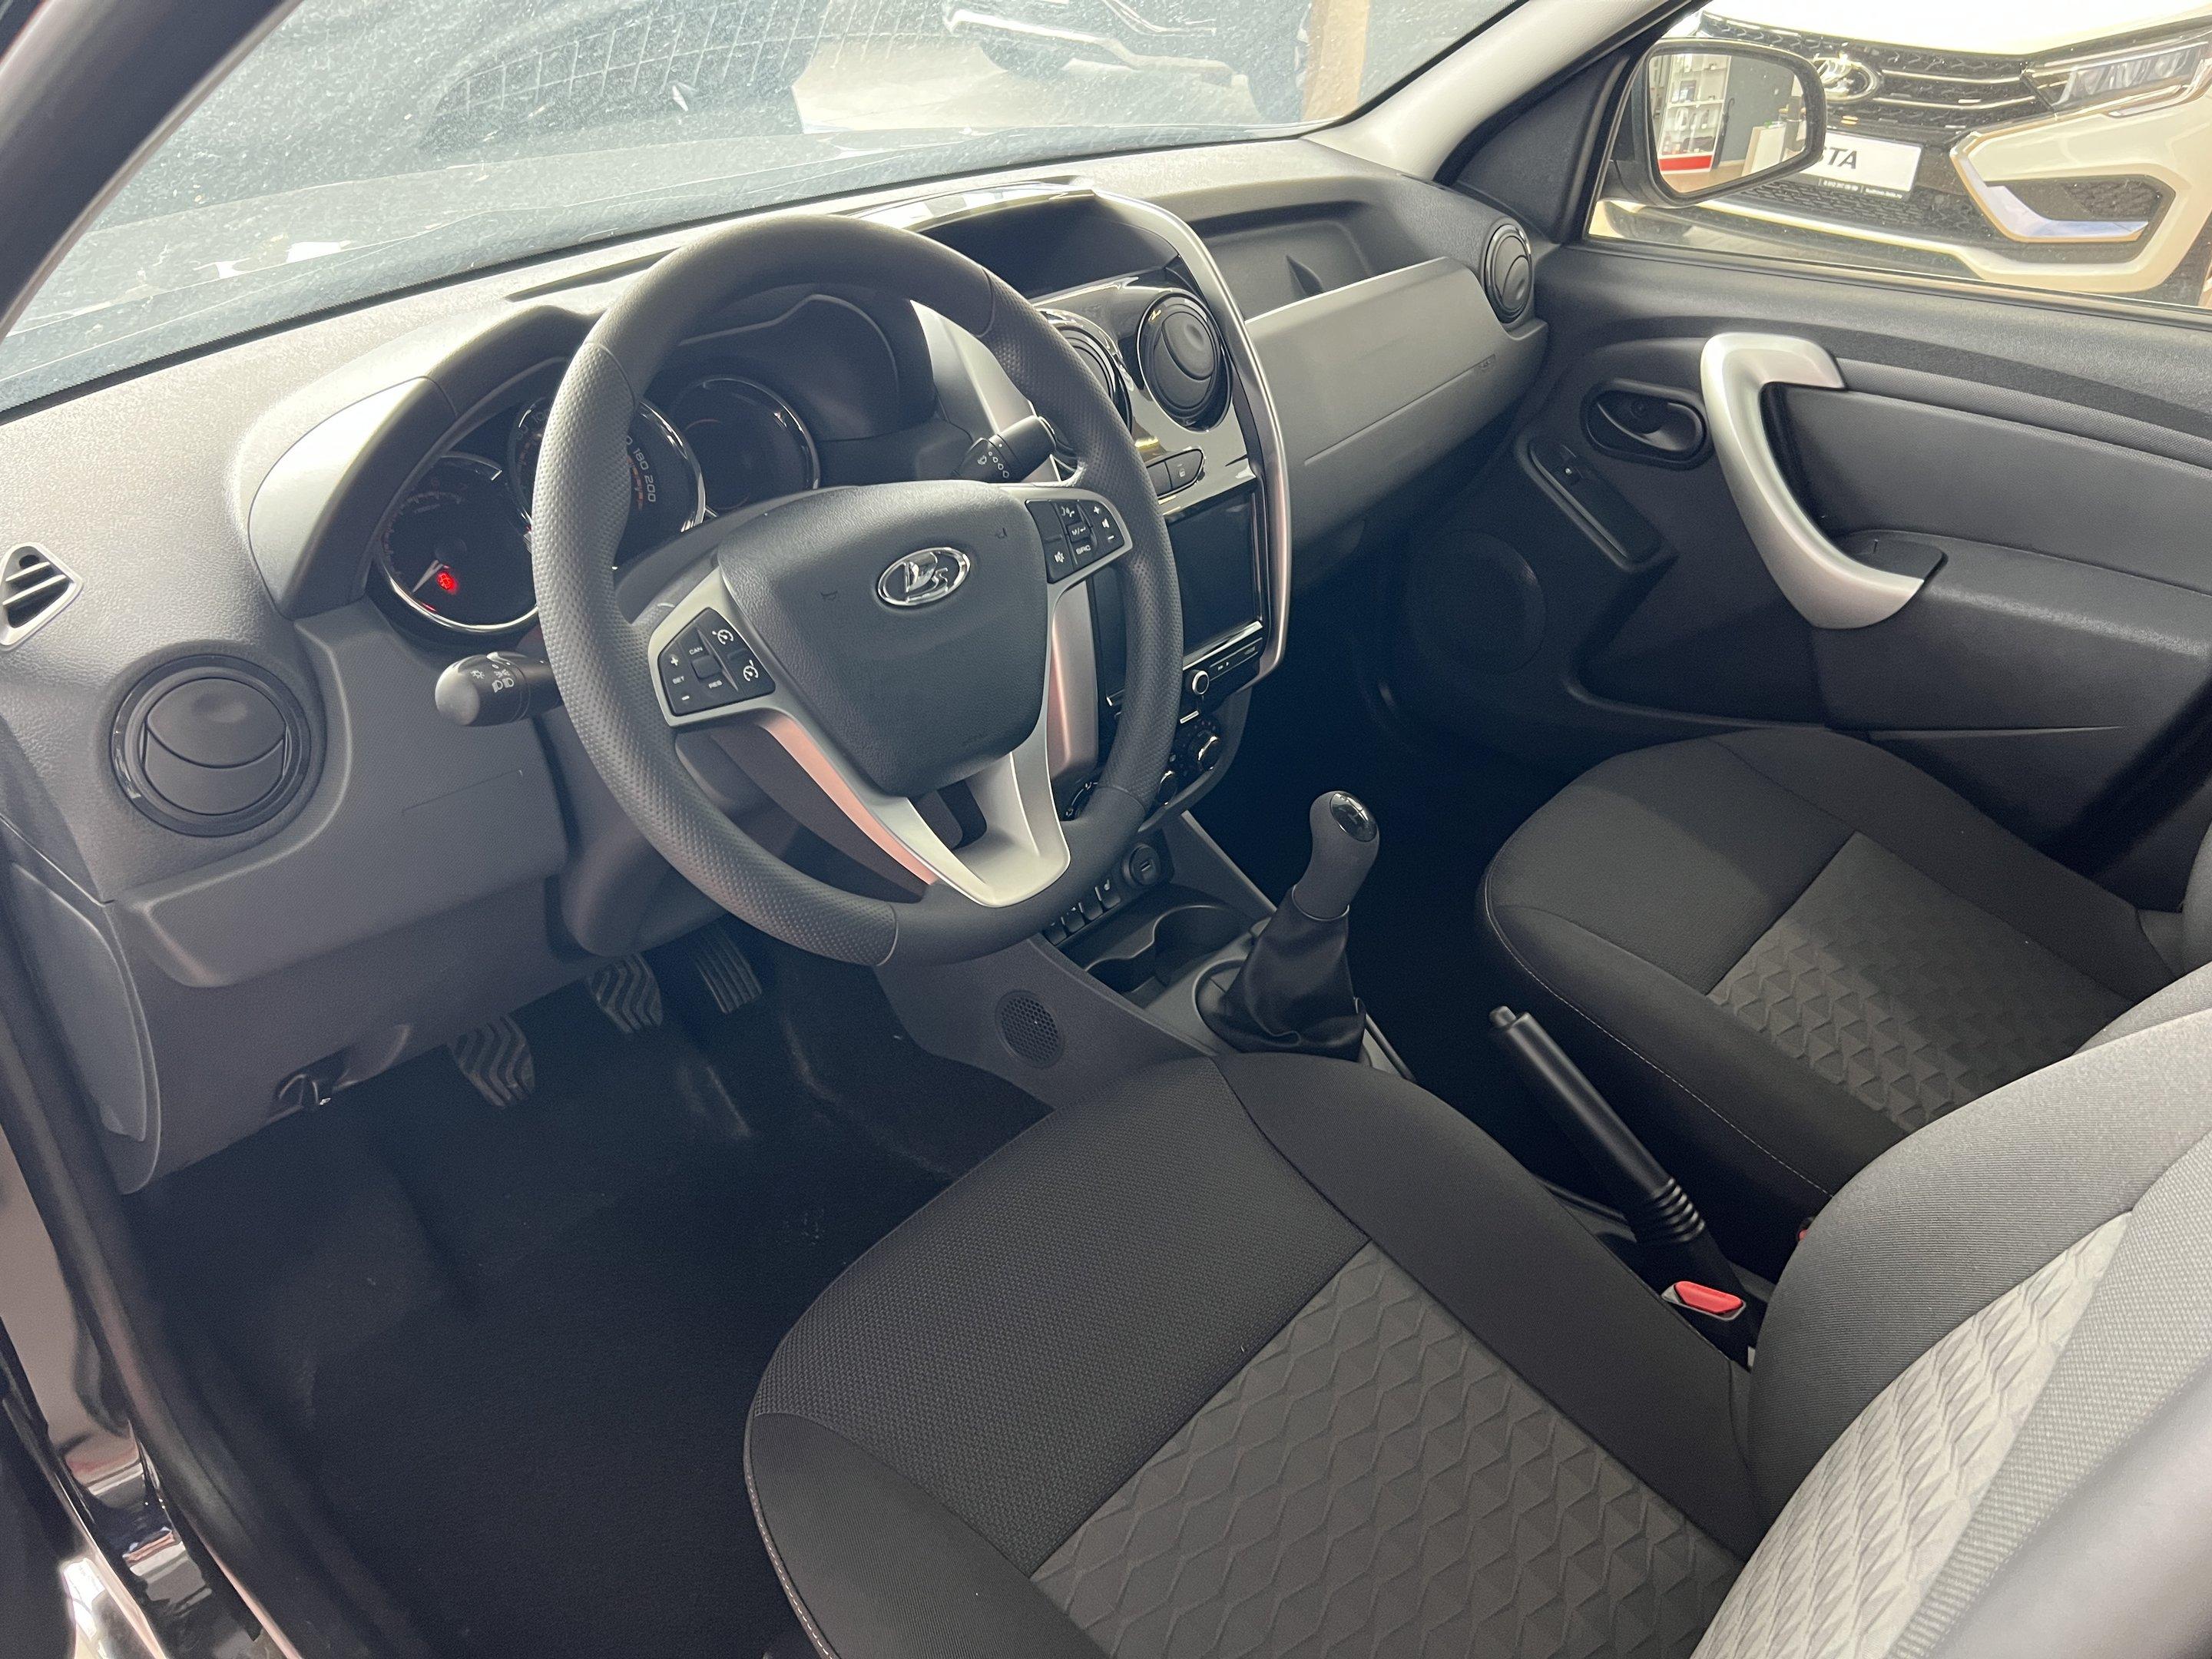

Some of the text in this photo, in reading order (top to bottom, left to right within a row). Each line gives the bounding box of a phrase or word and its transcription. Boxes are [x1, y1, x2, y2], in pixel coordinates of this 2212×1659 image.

[633, 448, 649, 470] 180
[644, 475, 656, 502] 200
[689, 646, 704, 655] CAN
